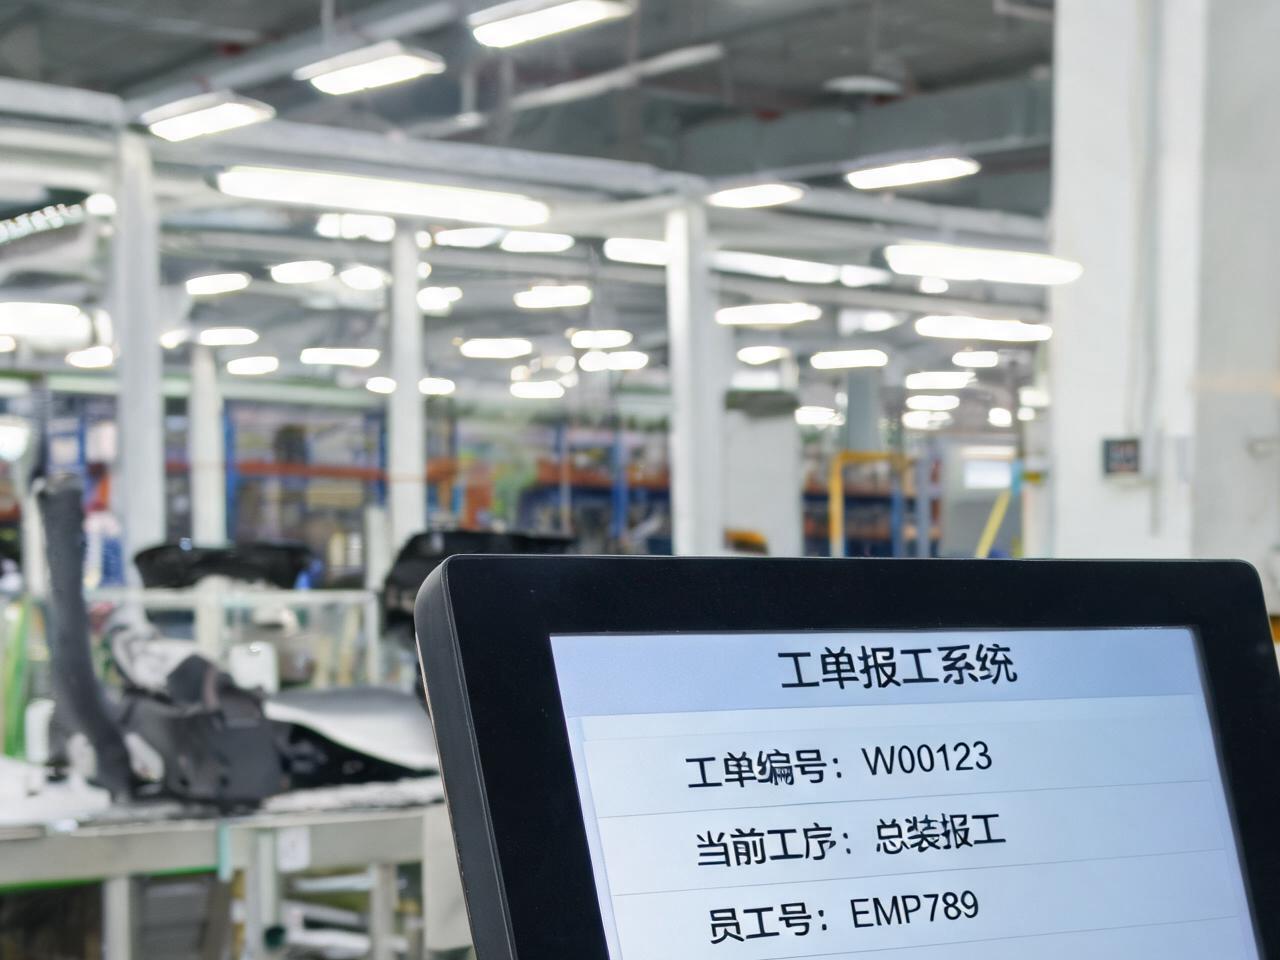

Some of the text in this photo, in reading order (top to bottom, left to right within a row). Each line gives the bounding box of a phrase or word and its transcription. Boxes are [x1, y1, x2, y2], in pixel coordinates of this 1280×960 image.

[777, 643, 1018, 690] 工单报工系统
[875, 812, 1007, 855] 总装报工
[849, 889, 980, 929] EMP789
